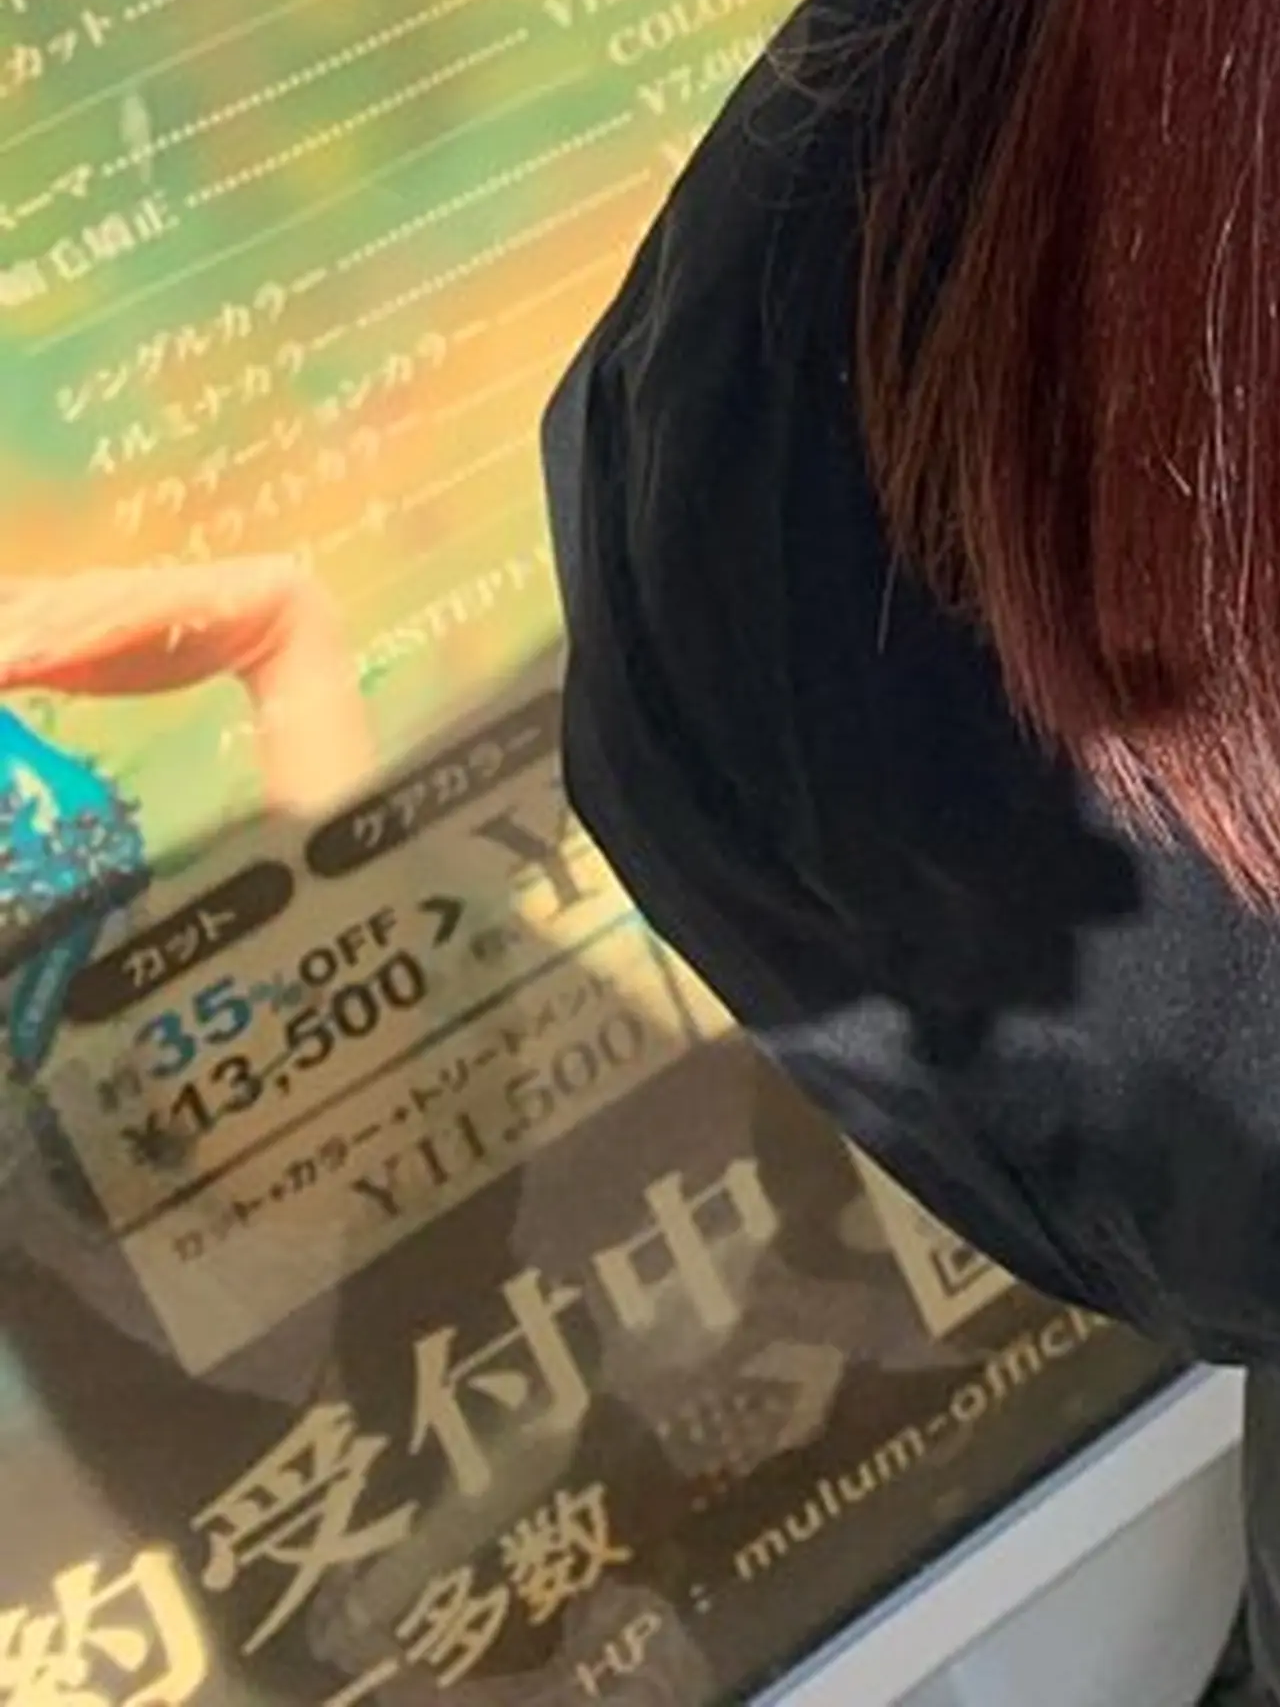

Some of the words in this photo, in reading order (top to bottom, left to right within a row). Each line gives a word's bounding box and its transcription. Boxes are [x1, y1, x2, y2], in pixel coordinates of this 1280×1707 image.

[122, 909, 237, 989] カット
[576, 1611, 662, 1695] HP
